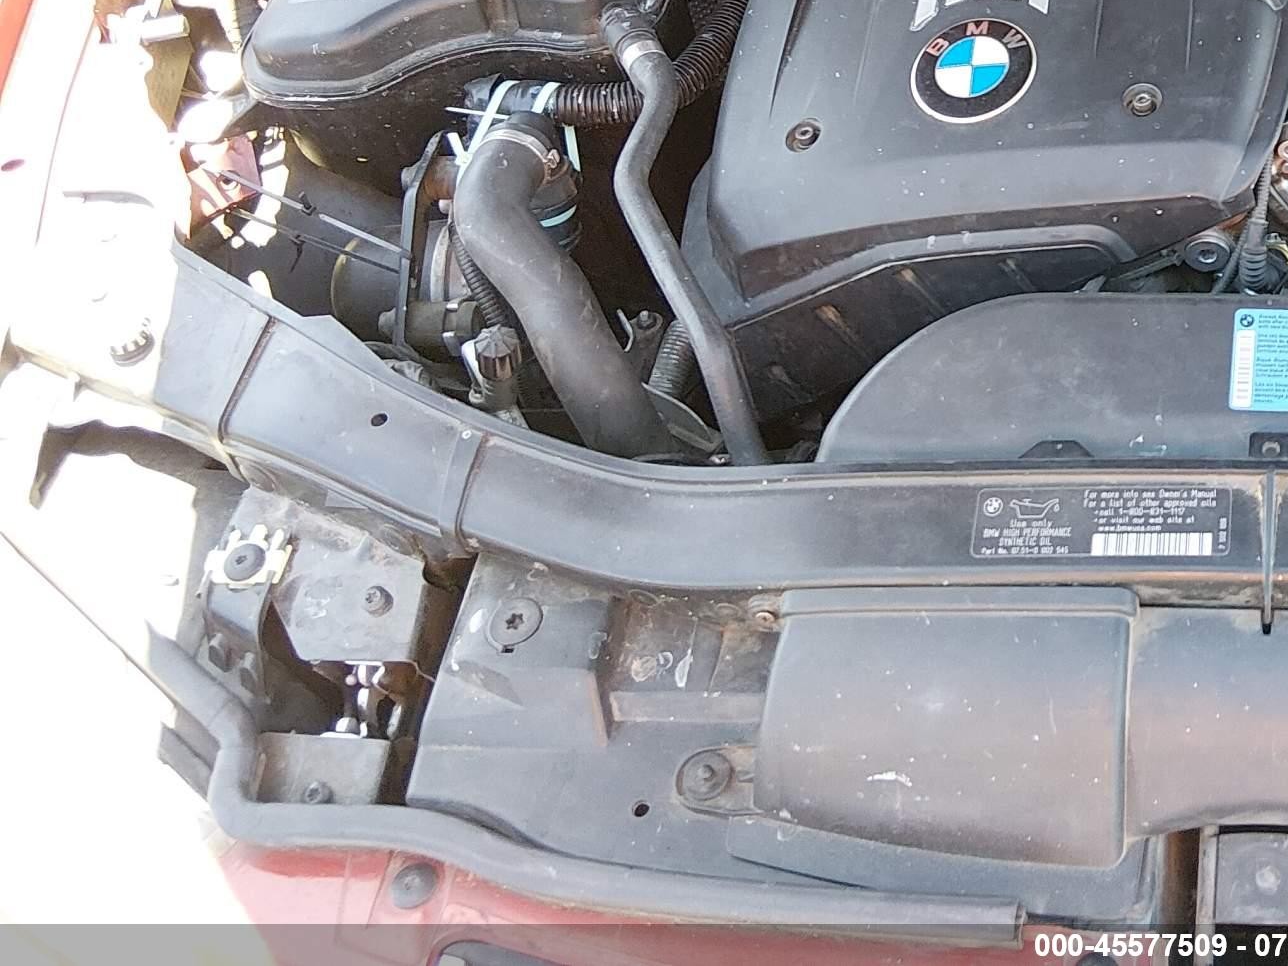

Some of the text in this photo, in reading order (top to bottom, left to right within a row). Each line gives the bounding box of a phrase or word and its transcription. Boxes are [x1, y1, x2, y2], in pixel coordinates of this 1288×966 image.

[926, 21, 1027, 56] BMW
[1124, 490, 1138, 498] info
[1191, 489, 1216, 498] Manual
[1127, 499, 1136, 508] of
[1164, 499, 1197, 508] approved
[1032, 519, 1053, 527] only
[983, 528, 1000, 538] BMW
[1023, 527, 1071, 536] PERFORMANCE
[999, 537, 1051, 546] SYNTHETIC OIL
